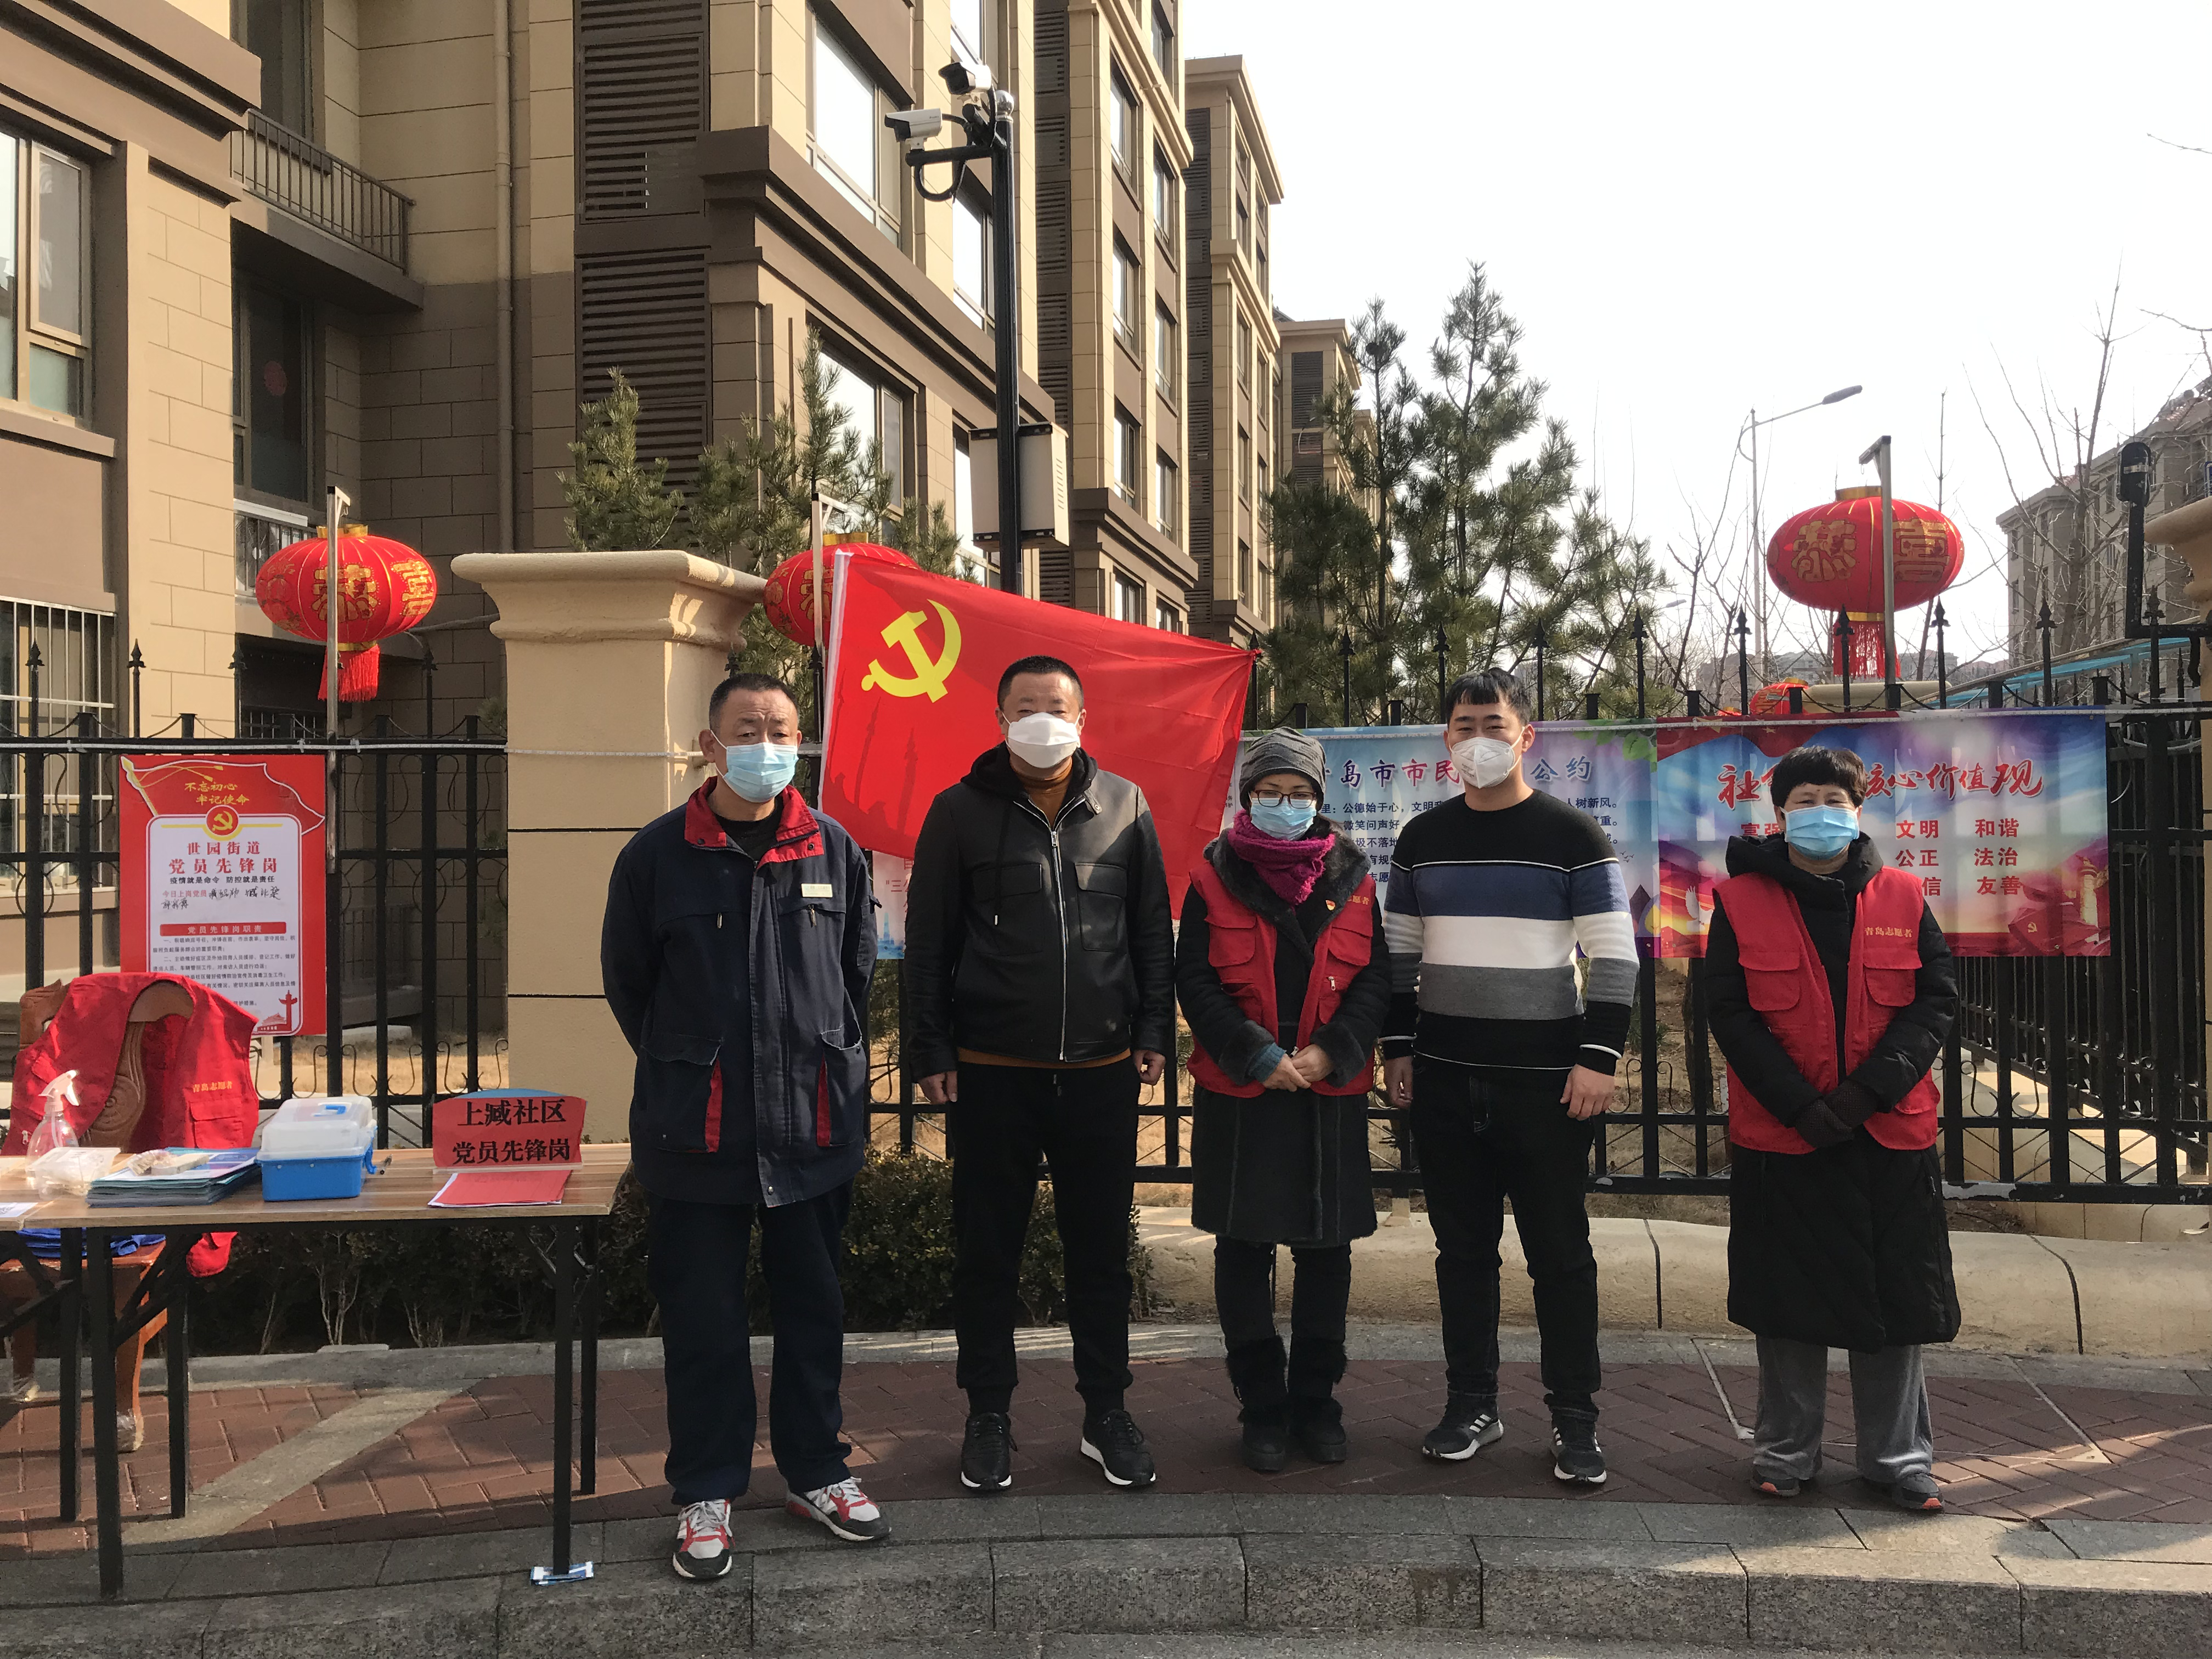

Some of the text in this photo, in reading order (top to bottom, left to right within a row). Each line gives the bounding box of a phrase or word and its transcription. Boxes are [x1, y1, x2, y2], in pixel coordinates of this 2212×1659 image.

[1325, 759, 1460, 789] 岛市市民
[184, 781, 238, 792] 不忘初心
[196, 794, 250, 806] 牢记使命
[1896, 820, 1939, 839] 文明
[1975, 818, 2020, 838] 和谐
[187, 841, 260, 855] 世园街道
[1352, 837, 1397, 848] 圾不落地
[1895, 847, 2018, 867] 公正 法治
[168, 857, 276, 874] 党员先锋岗
[170, 875, 275, 884] 疫情就是命令 防控就是责任
[1977, 876, 2022, 895] 友善
[162, 889, 207, 898] 今日上岗党员
[1348, 895, 1369, 905] 愿者
[187, 924, 262, 934] 党员先锋岗职责
[1865, 926, 1913, 938] 青岛志愿者
[457, 1098, 566, 1126] 上臧社区
[452, 1138, 570, 1165] 党员先锋岗
